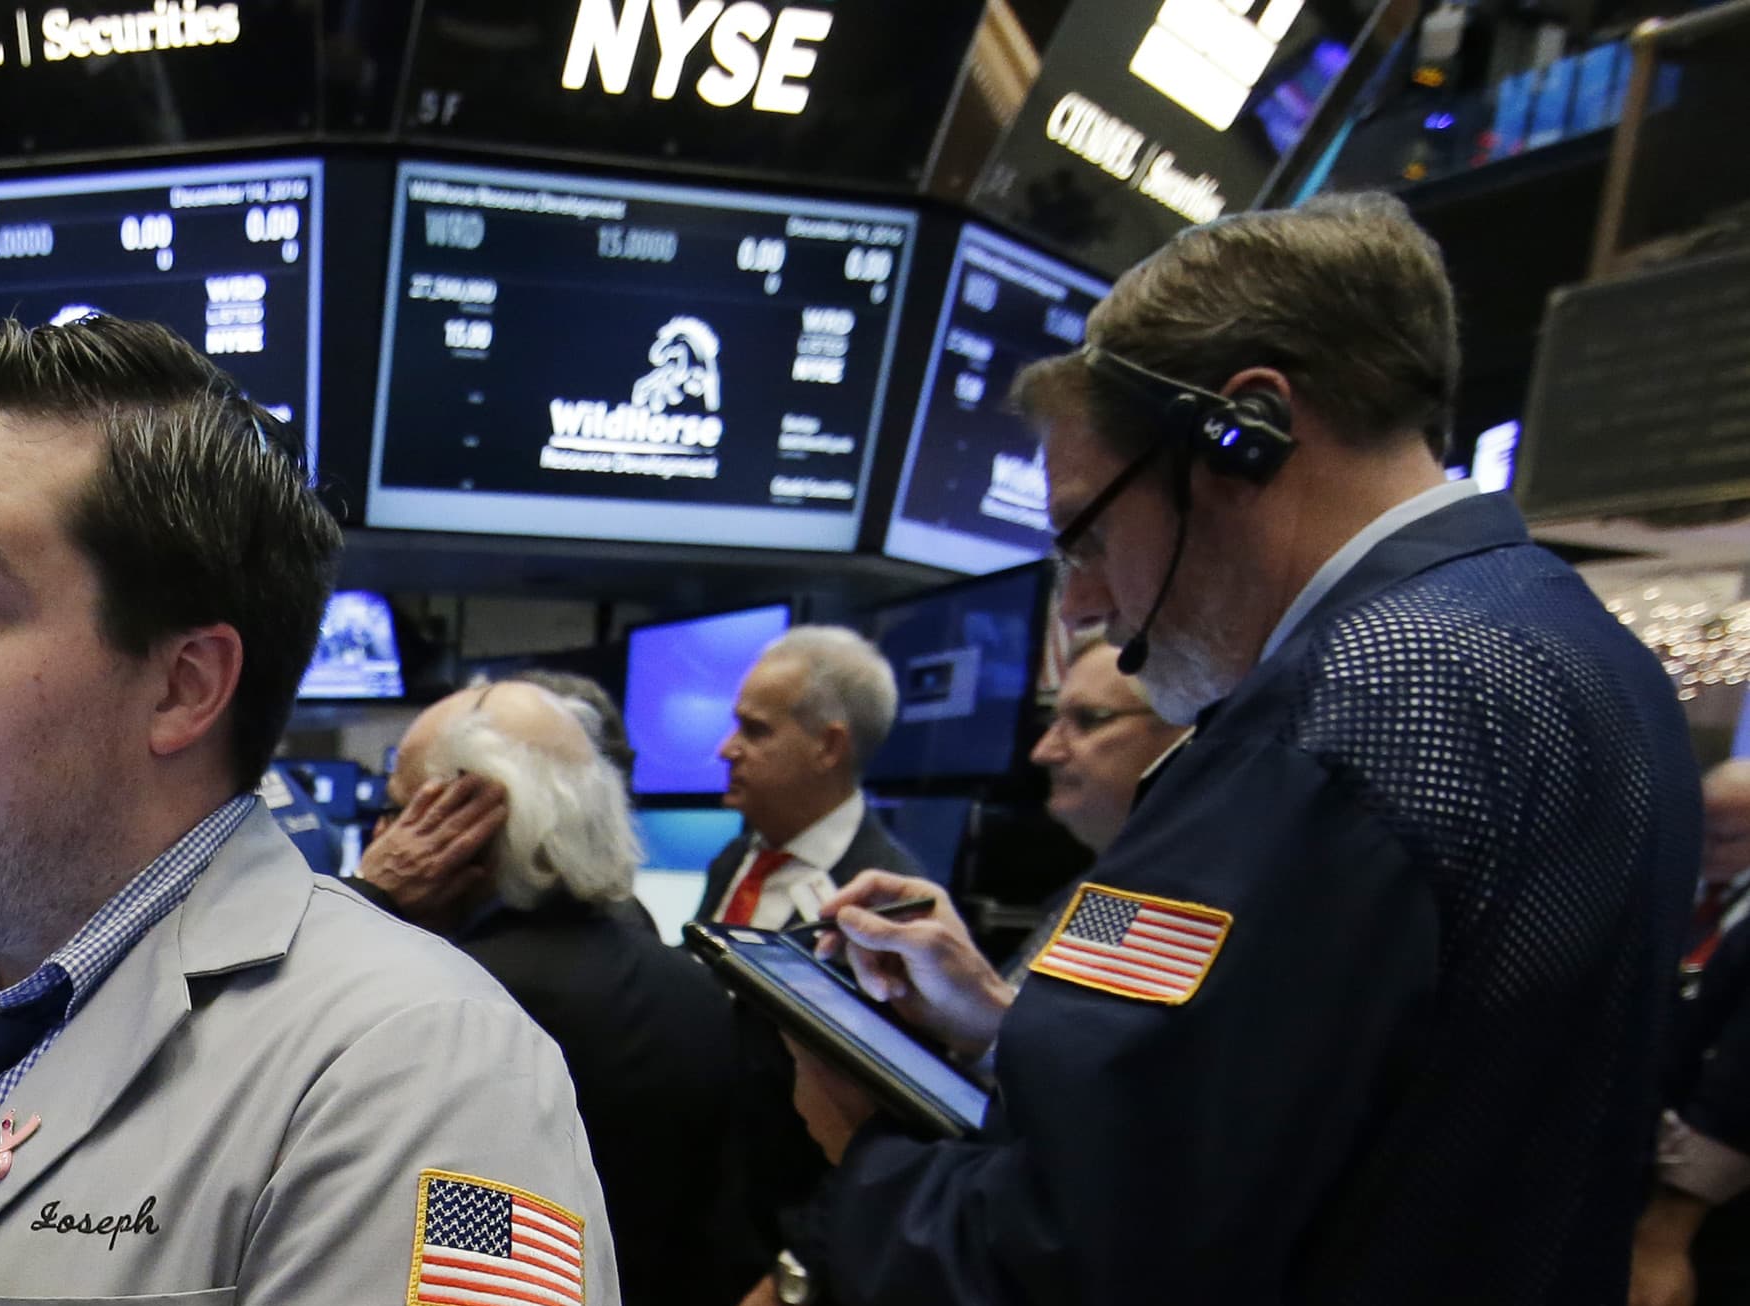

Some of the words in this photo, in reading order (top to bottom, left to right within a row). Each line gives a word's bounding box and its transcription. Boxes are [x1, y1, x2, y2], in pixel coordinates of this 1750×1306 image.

[41, 0, 240, 62] Securities
[561, 0, 834, 115] NYSE
[120, 213, 174, 251] 0.00
[245, 204, 300, 243] 0.00
[736, 235, 787, 273] 0.00
[549, 396, 724, 448] WildHorse
[29, 1195, 160, 1251] Joseph
